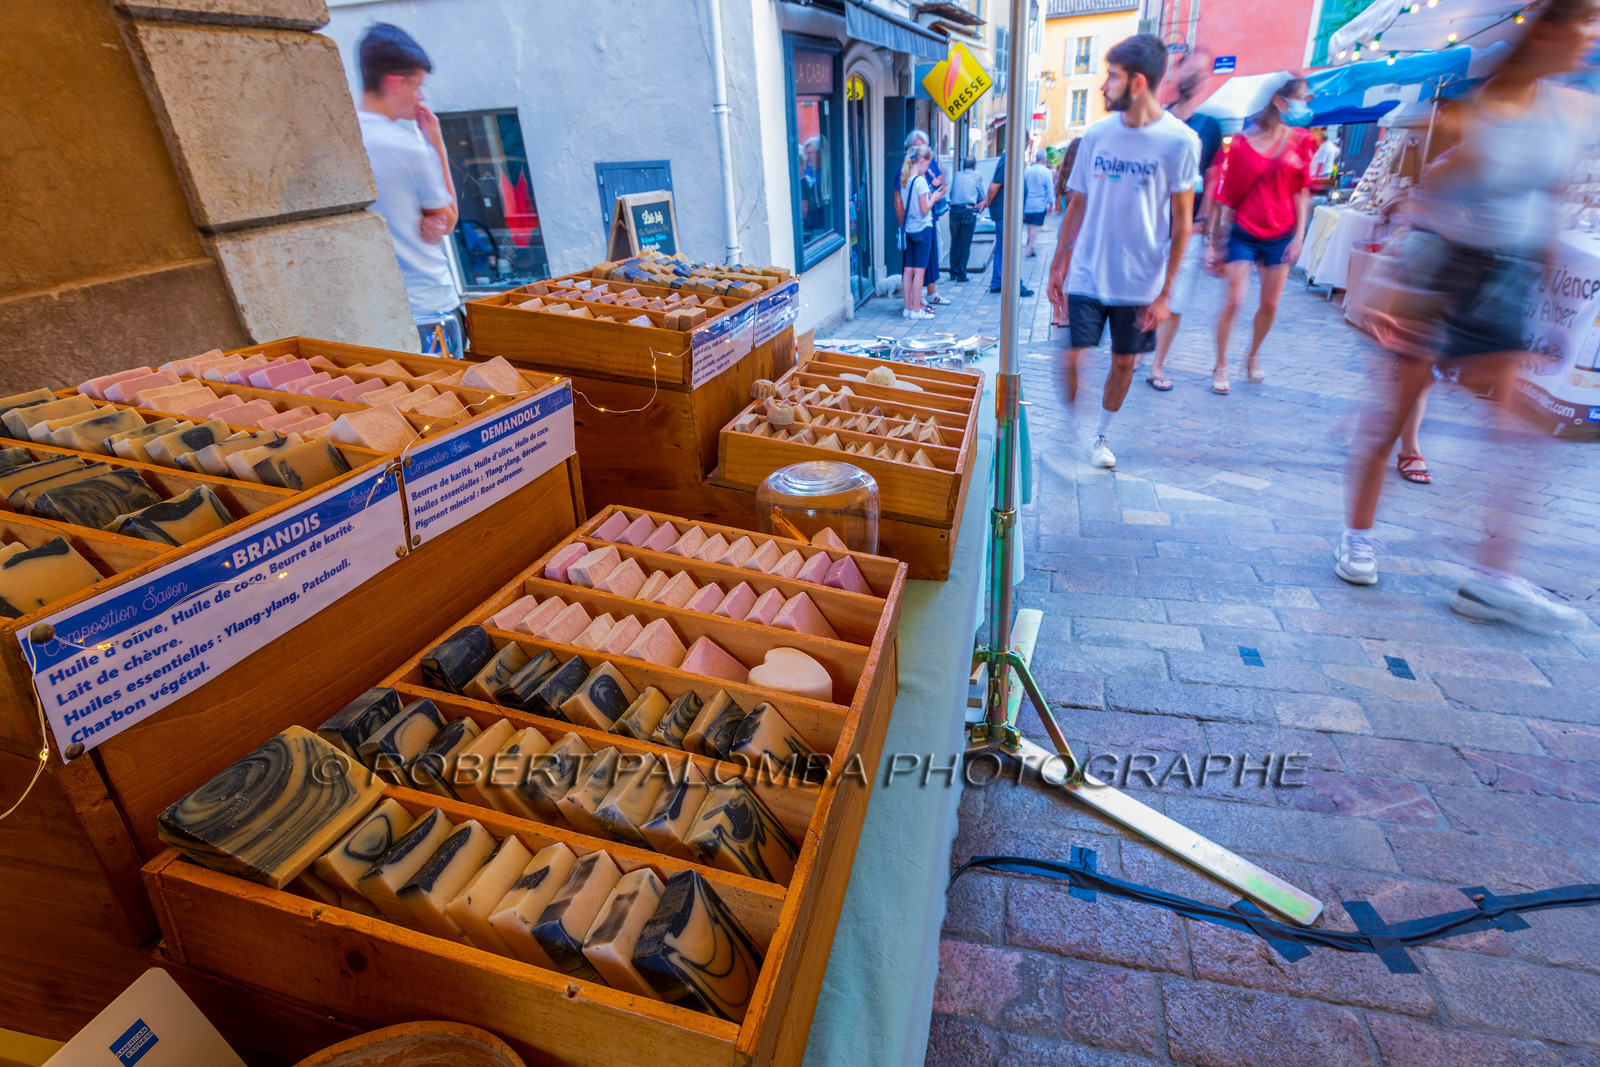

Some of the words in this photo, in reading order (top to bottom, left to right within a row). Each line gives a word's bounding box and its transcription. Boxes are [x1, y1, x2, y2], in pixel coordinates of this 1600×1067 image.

[948, 76, 985, 116] PRESSE
[1094, 156, 1159, 175] Polaroid
[409, 451, 449, 475] Composition
[481, 404, 541, 443] DEMANDOLX
[411, 483, 438, 501] Beurre
[440, 477, 449, 488] de
[450, 465, 473, 482] karité,
[474, 457, 491, 470] Huile
[515, 437, 529, 449] Huile
[530, 432, 536, 441] de
[414, 499, 439, 516] Huiles
[440, 477, 480, 502] essentielles
[485, 455, 521, 478] Ylang-ylang,
[522, 440, 547, 457] Géranium.
[415, 507, 448, 530] Pigment
[449, 491, 476, 512] minéral
[480, 482, 495, 494] Rose
[496, 467, 524, 485] outremer.
[36, 605, 137, 657] Composition
[143, 581, 188, 610] Savon
[232, 512, 321, 570] BRANDIS
[49, 653, 99, 686] Huile
[171, 598, 211, 625] Huile
[214, 590, 231, 604] de
[234, 572, 267, 592] coco,
[269, 549, 307, 574] Beurre
[309, 539, 322, 553] de
[323, 522, 355, 545] karité.
[56, 681, 93, 706] Lait
[96, 668, 119, 685] de
[124, 639, 183, 671] chèvre.
[64, 689, 122, 726] Huiles
[127, 639, 214, 692] essentielles
[224, 592, 300, 637] Ylang-ylang,
[302, 558, 351, 593] Patchouli.
[71, 699, 146, 743] Charbon
[150, 662, 210, 701] végétal.
[116, 1026, 148, 1058] AMERICAN
[125, 1030, 154, 1059] EXPRESS
